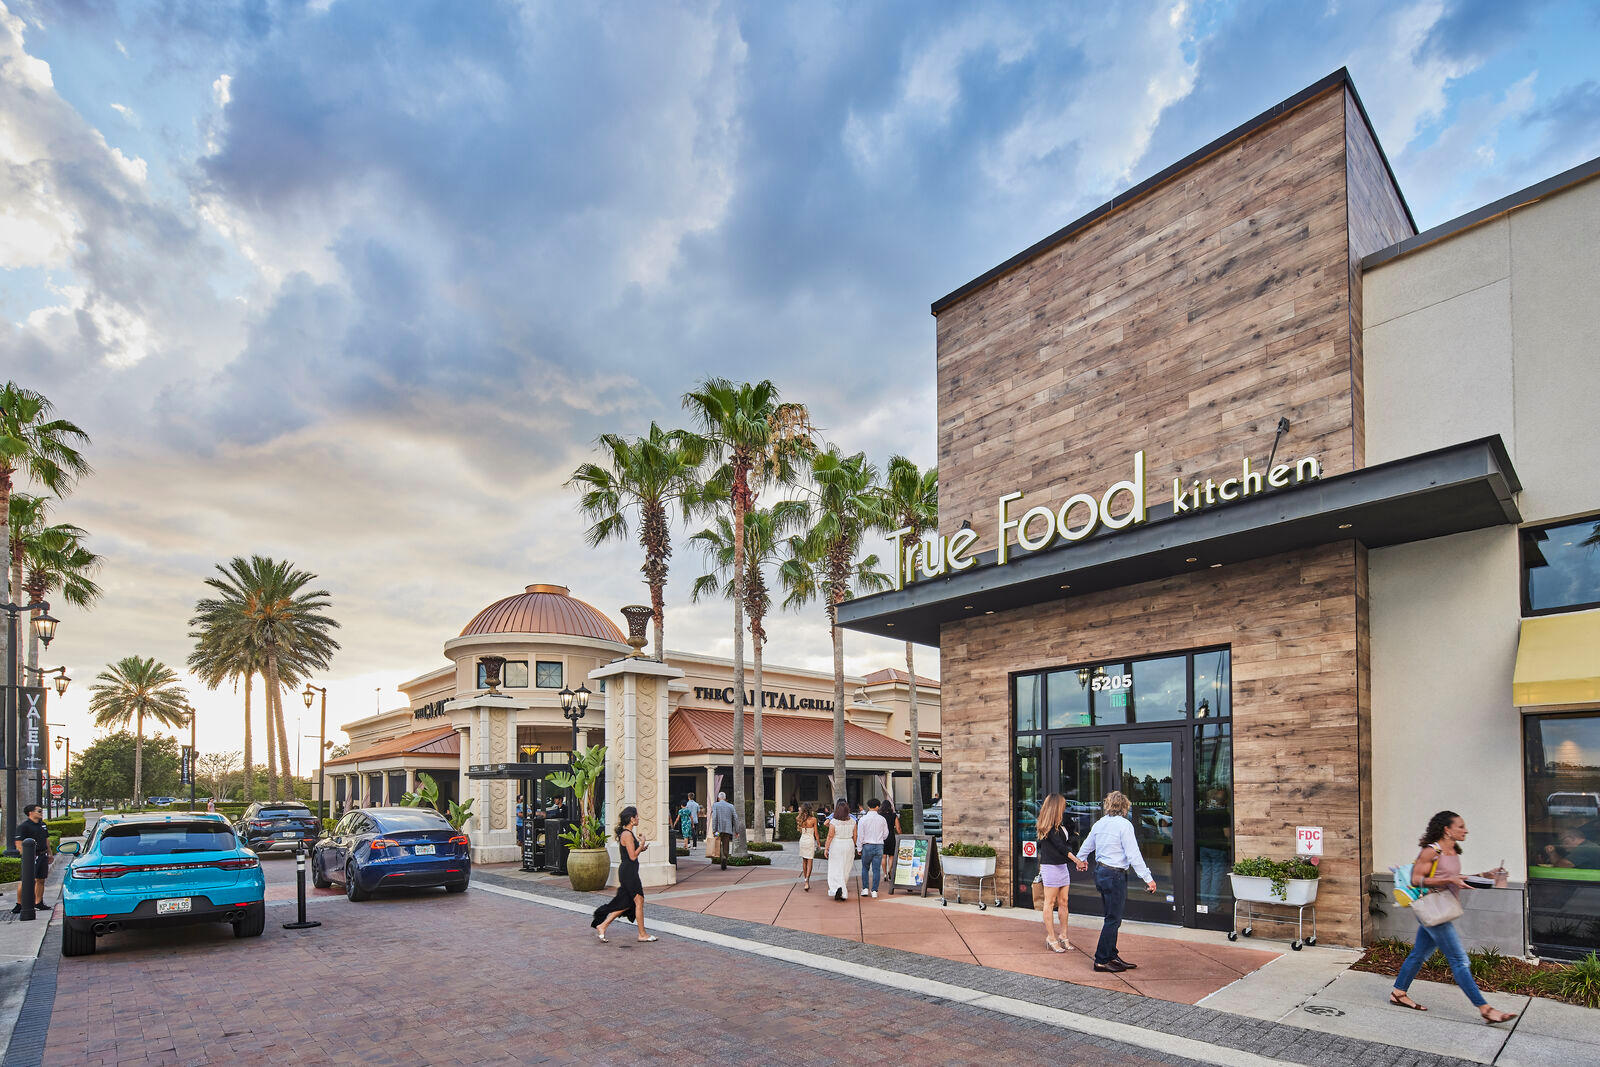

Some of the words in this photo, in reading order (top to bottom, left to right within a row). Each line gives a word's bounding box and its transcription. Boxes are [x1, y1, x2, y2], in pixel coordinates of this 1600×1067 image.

[885, 526, 980, 591] True
[998, 450, 1147, 565] Food
[1173, 456, 1321, 514] kitchen
[1091, 674, 1132, 691] 5205
[694, 686, 722, 700] THE
[26, 693, 41, 756] VALET
[1298, 830, 1320, 840] FDC
